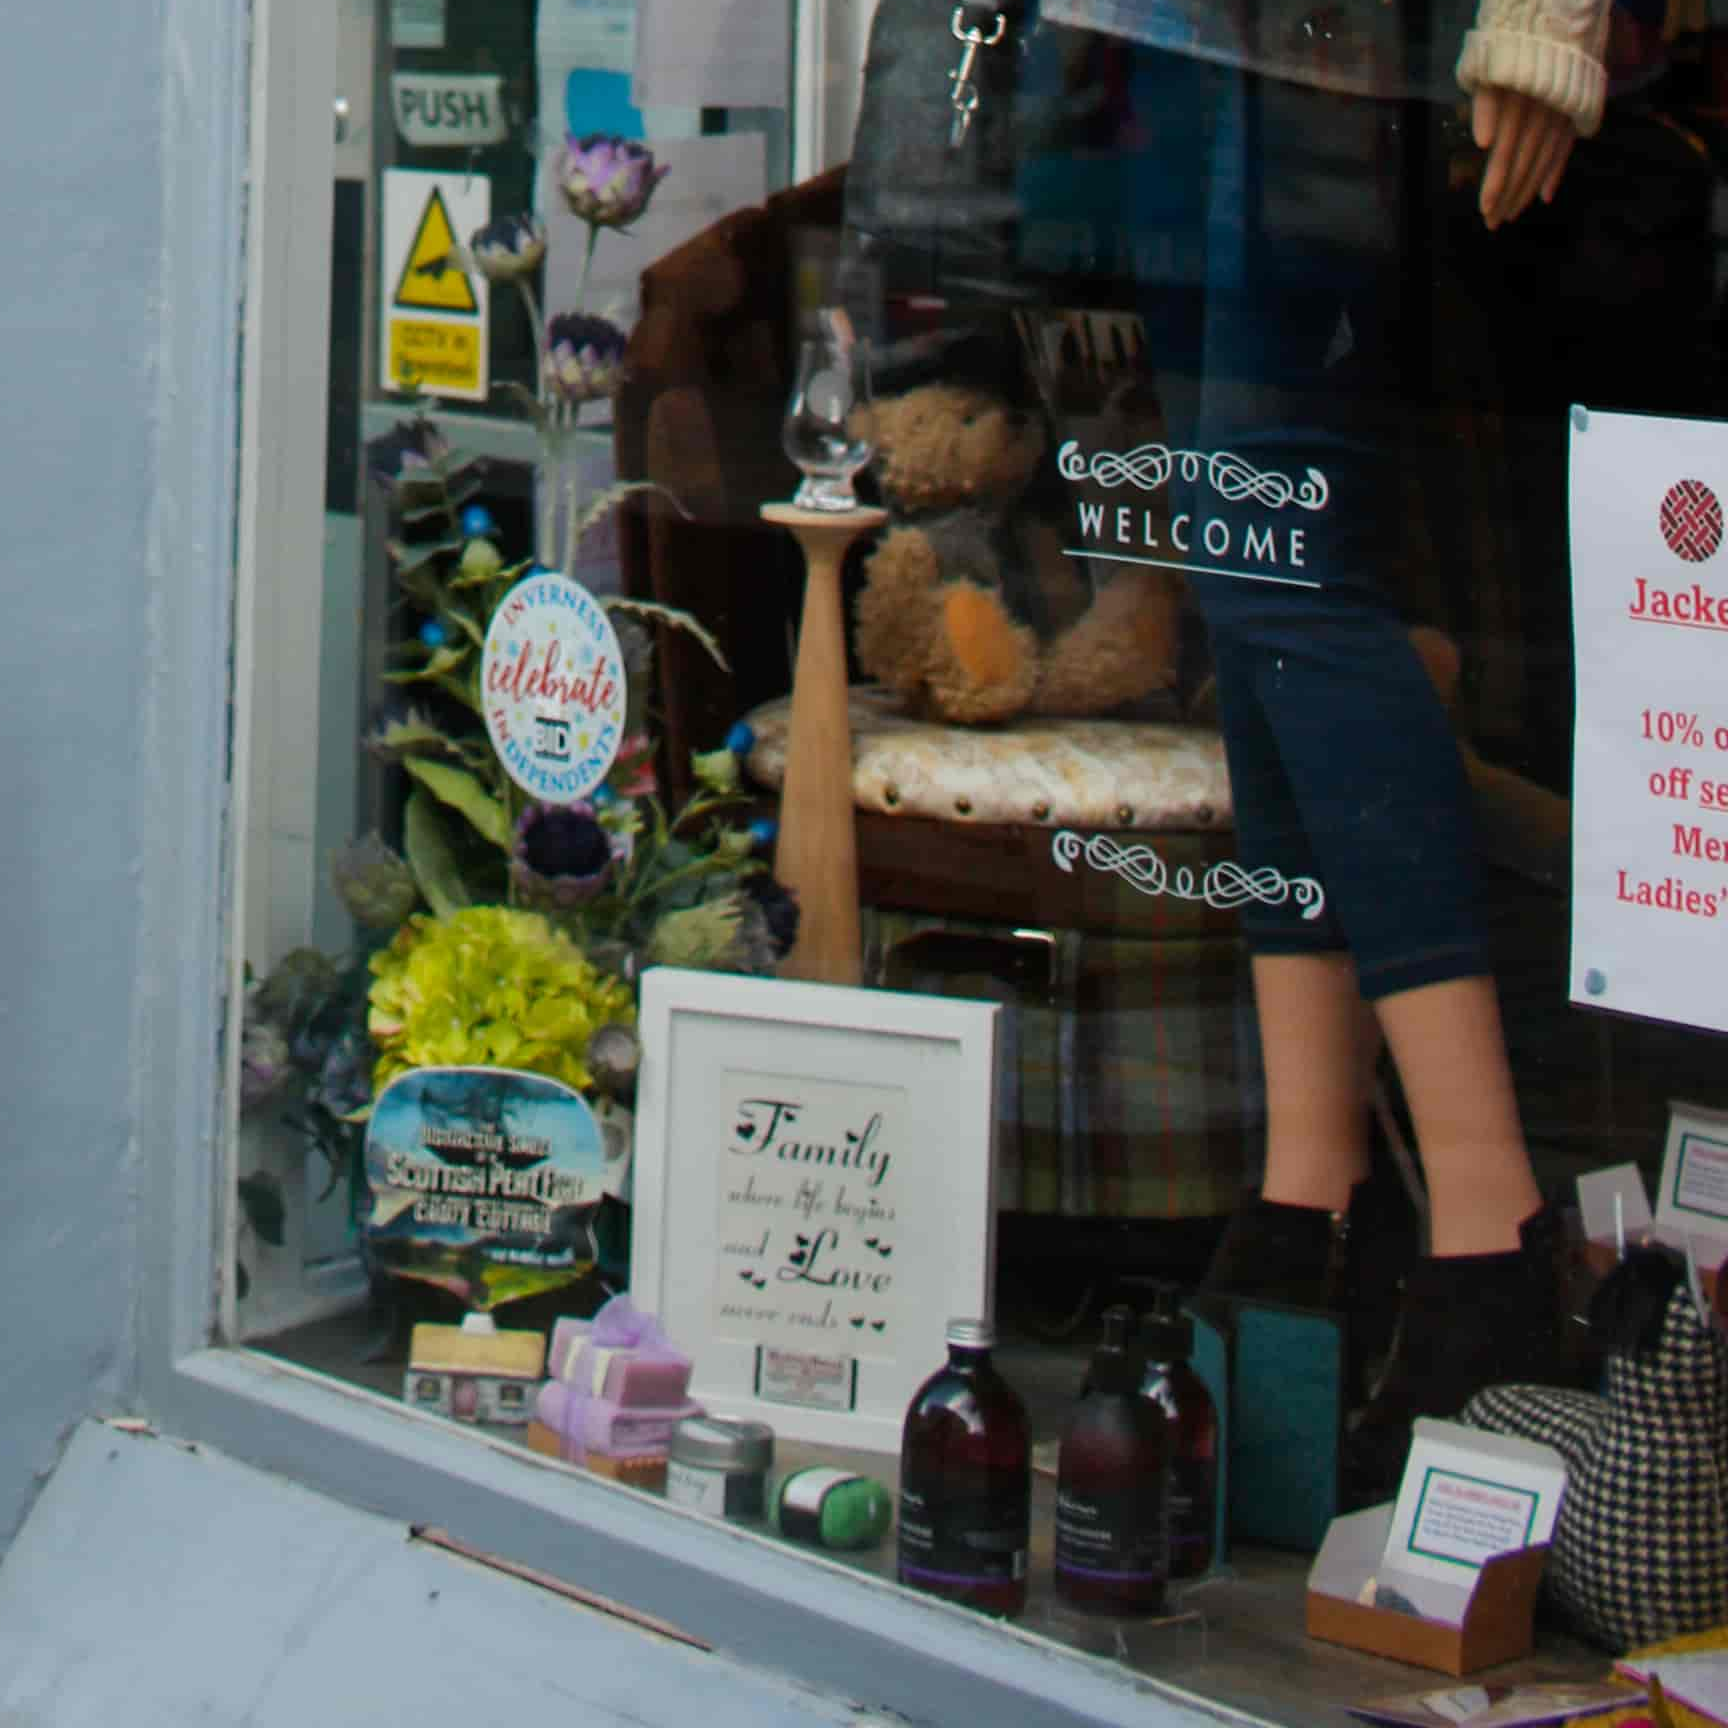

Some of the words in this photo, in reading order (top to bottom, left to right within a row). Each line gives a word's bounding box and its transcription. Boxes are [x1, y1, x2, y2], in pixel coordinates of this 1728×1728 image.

[399, 88, 490, 129] PUSH
[1078, 501, 1306, 567] WELCOME
[502, 583, 607, 642] INVERNESS
[486, 639, 616, 714] celebrate
[492, 708, 615, 792] INDEPENDENTS
[1642, 707, 1704, 748] 10%
[1649, 767, 1693, 801] off
[728, 1099, 891, 1188] Family
[386, 1152, 487, 1195] SCOTTISH
[489, 1166, 542, 1199] PEAT
[778, 1227, 892, 1294] Love
